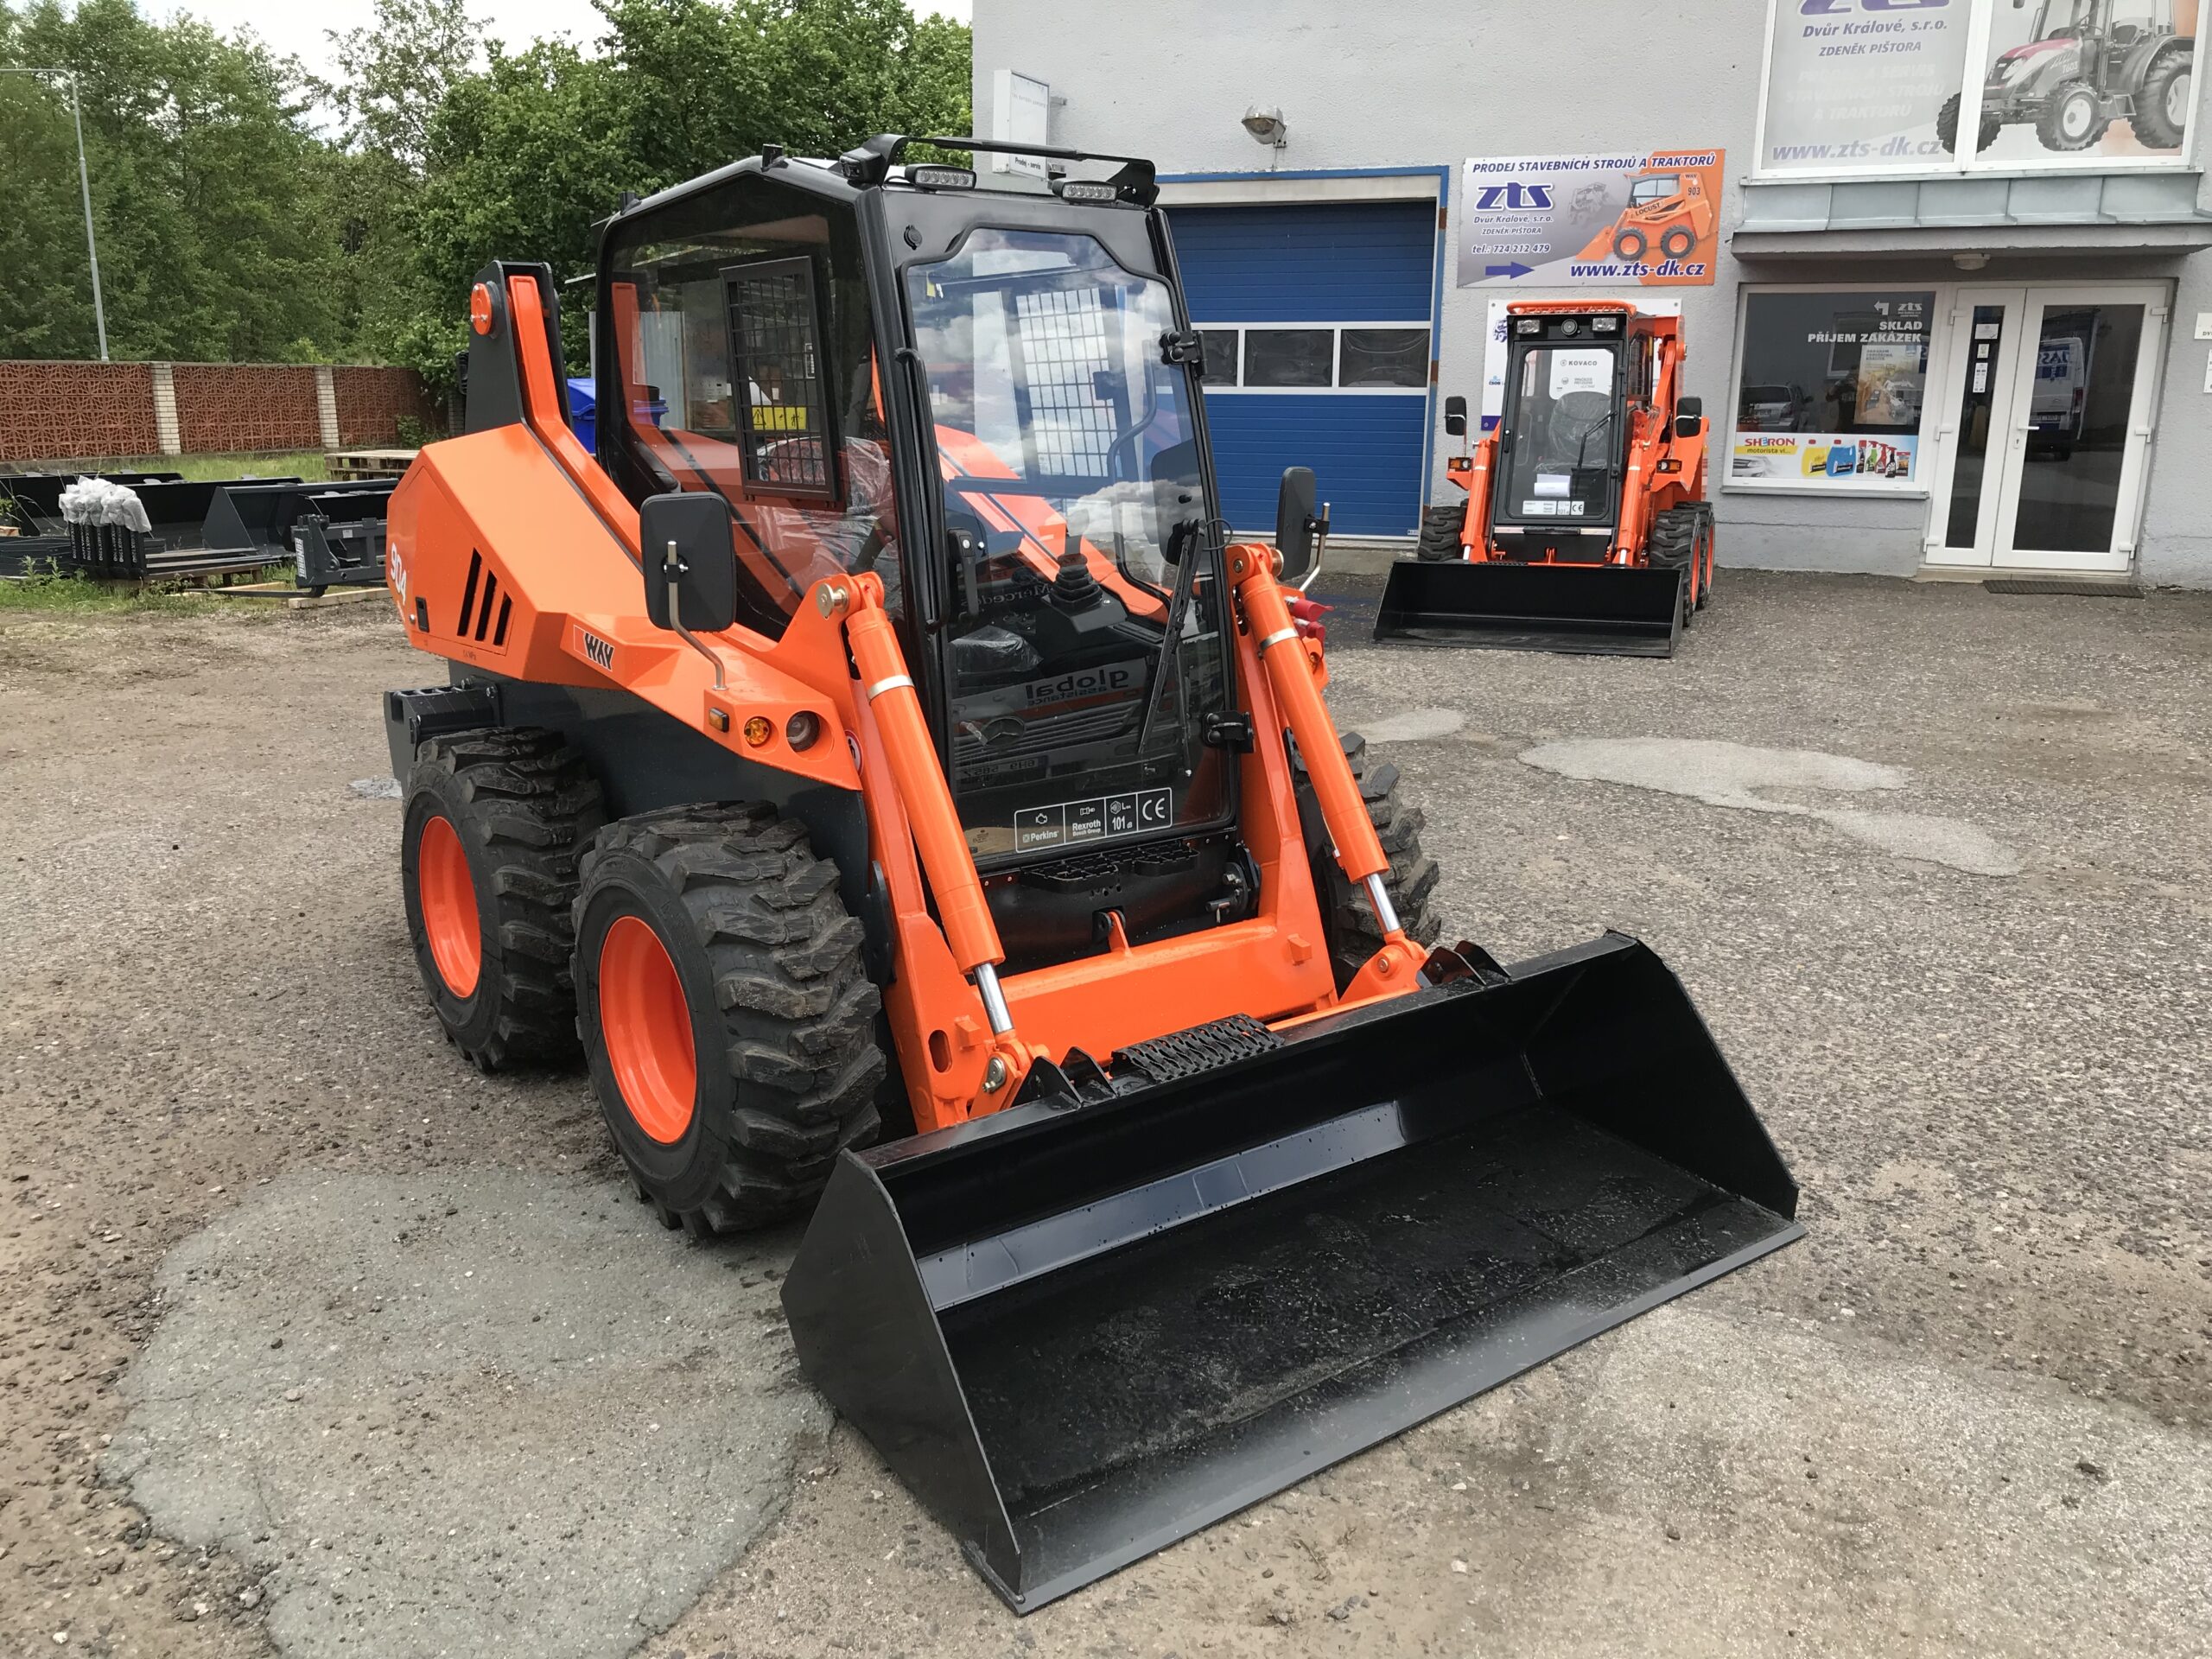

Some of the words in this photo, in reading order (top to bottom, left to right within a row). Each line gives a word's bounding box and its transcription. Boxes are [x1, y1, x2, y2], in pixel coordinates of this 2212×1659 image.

[1843, 18, 1906, 35] Králové,
[1910, 19, 1948, 31] s.r.o.
[1869, 41, 1922, 54] PIŠTORA
[1772, 136, 1942, 160] www.zts-dk.cz
[1472, 162, 1516, 173] PRODEJ
[1518, 158, 1590, 171] STAVEBNÍCH
[1593, 156, 1636, 168] STROJŮ
[1638, 158, 1647, 168] A
[1651, 152, 1715, 167] TRAKTORŮ
[1688, 187, 1700, 195] 903
[1634, 202, 1661, 217] LOCUST
[1472, 245, 1491, 253] tel.:
[1571, 259, 1705, 276] www.zts-dk.cz
[1878, 321, 1923, 330] SKLAD
[1808, 331, 1856, 343] PŘÍJEM
[1859, 331, 1922, 342] ZAKÁZEK
[1745, 436, 1796, 447] SHERON
[391, 542, 407, 606] 904
[583, 632, 615, 671] WAY
[1072, 819, 1102, 831] Rexroth
[1111, 816, 1126, 831] 101
[1030, 830, 1058, 842] Perkins
